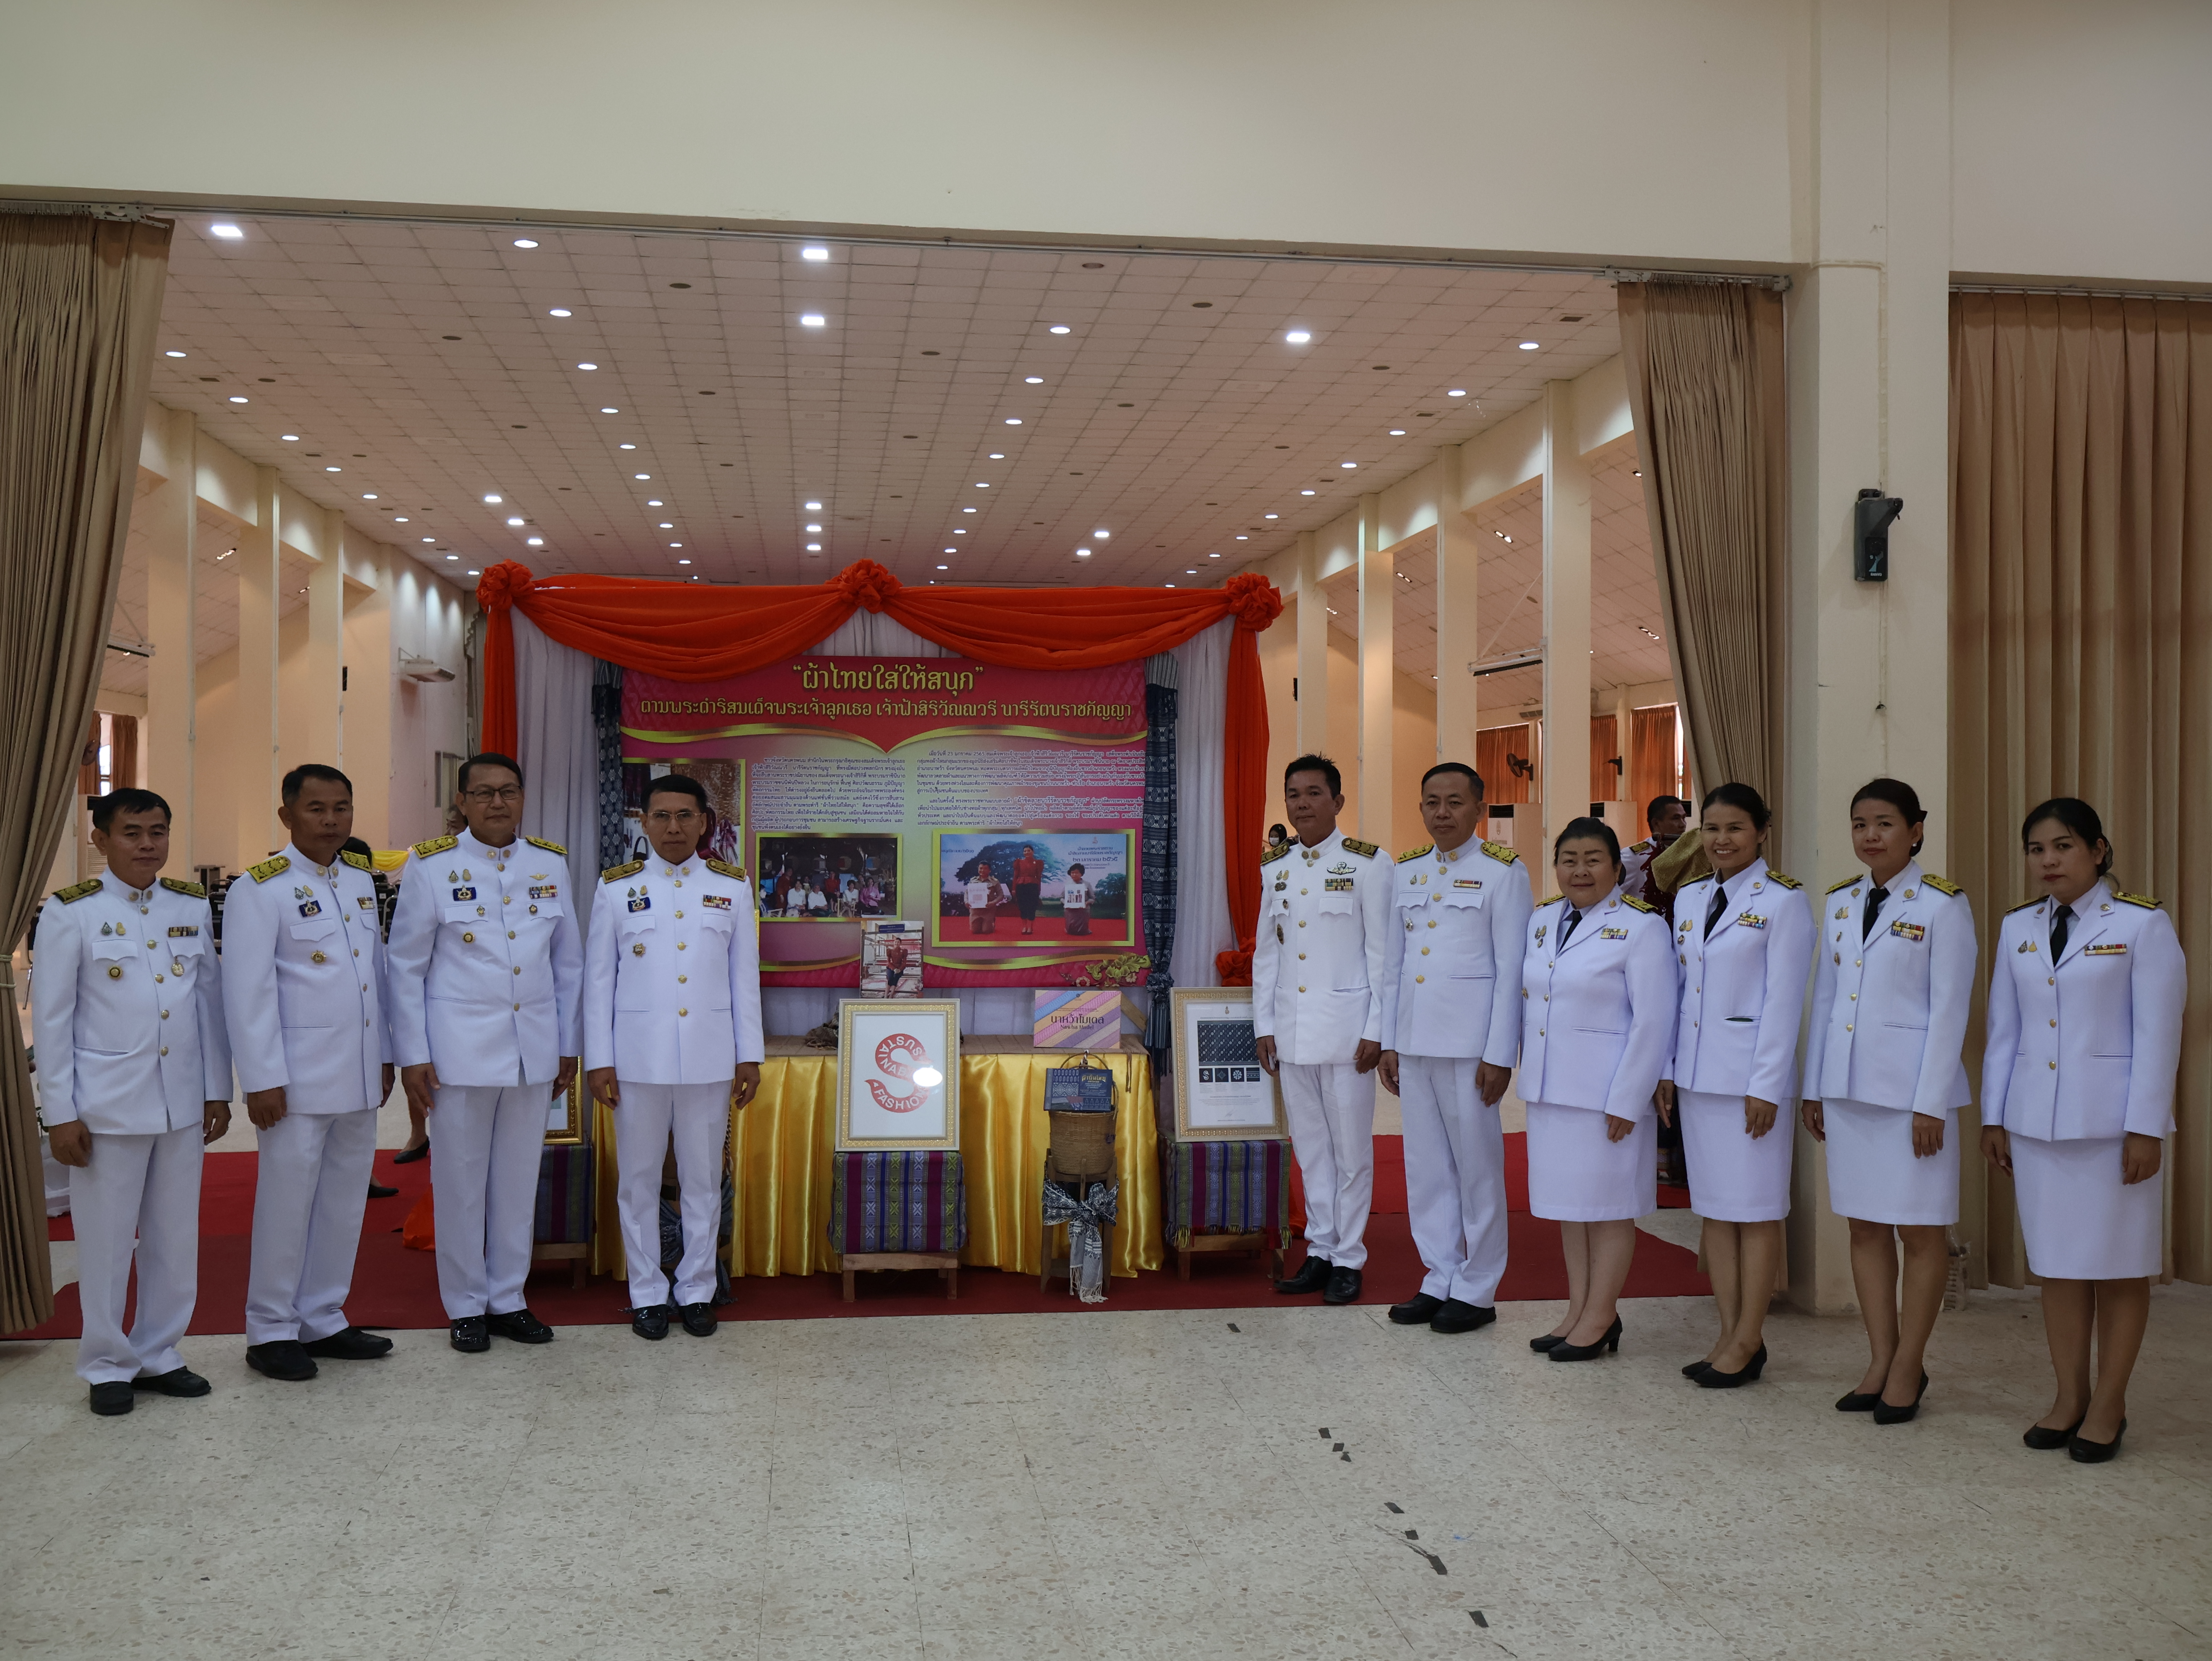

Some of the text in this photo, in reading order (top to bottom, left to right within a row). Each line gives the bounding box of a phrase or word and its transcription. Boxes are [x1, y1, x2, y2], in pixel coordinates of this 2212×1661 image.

[793, 662, 983, 697] “ผ้าไทยใส่ให้สนุก”
[641, 697, 1132, 720] ตามพระดำริสมเด็จพระเจ้าลูกเธอ เจ้าฟ้าสิริวัณณวรี นารีรัตนราชกัญญา
[1051, 1013, 1104, 1024] นาหว้าโมเดล
